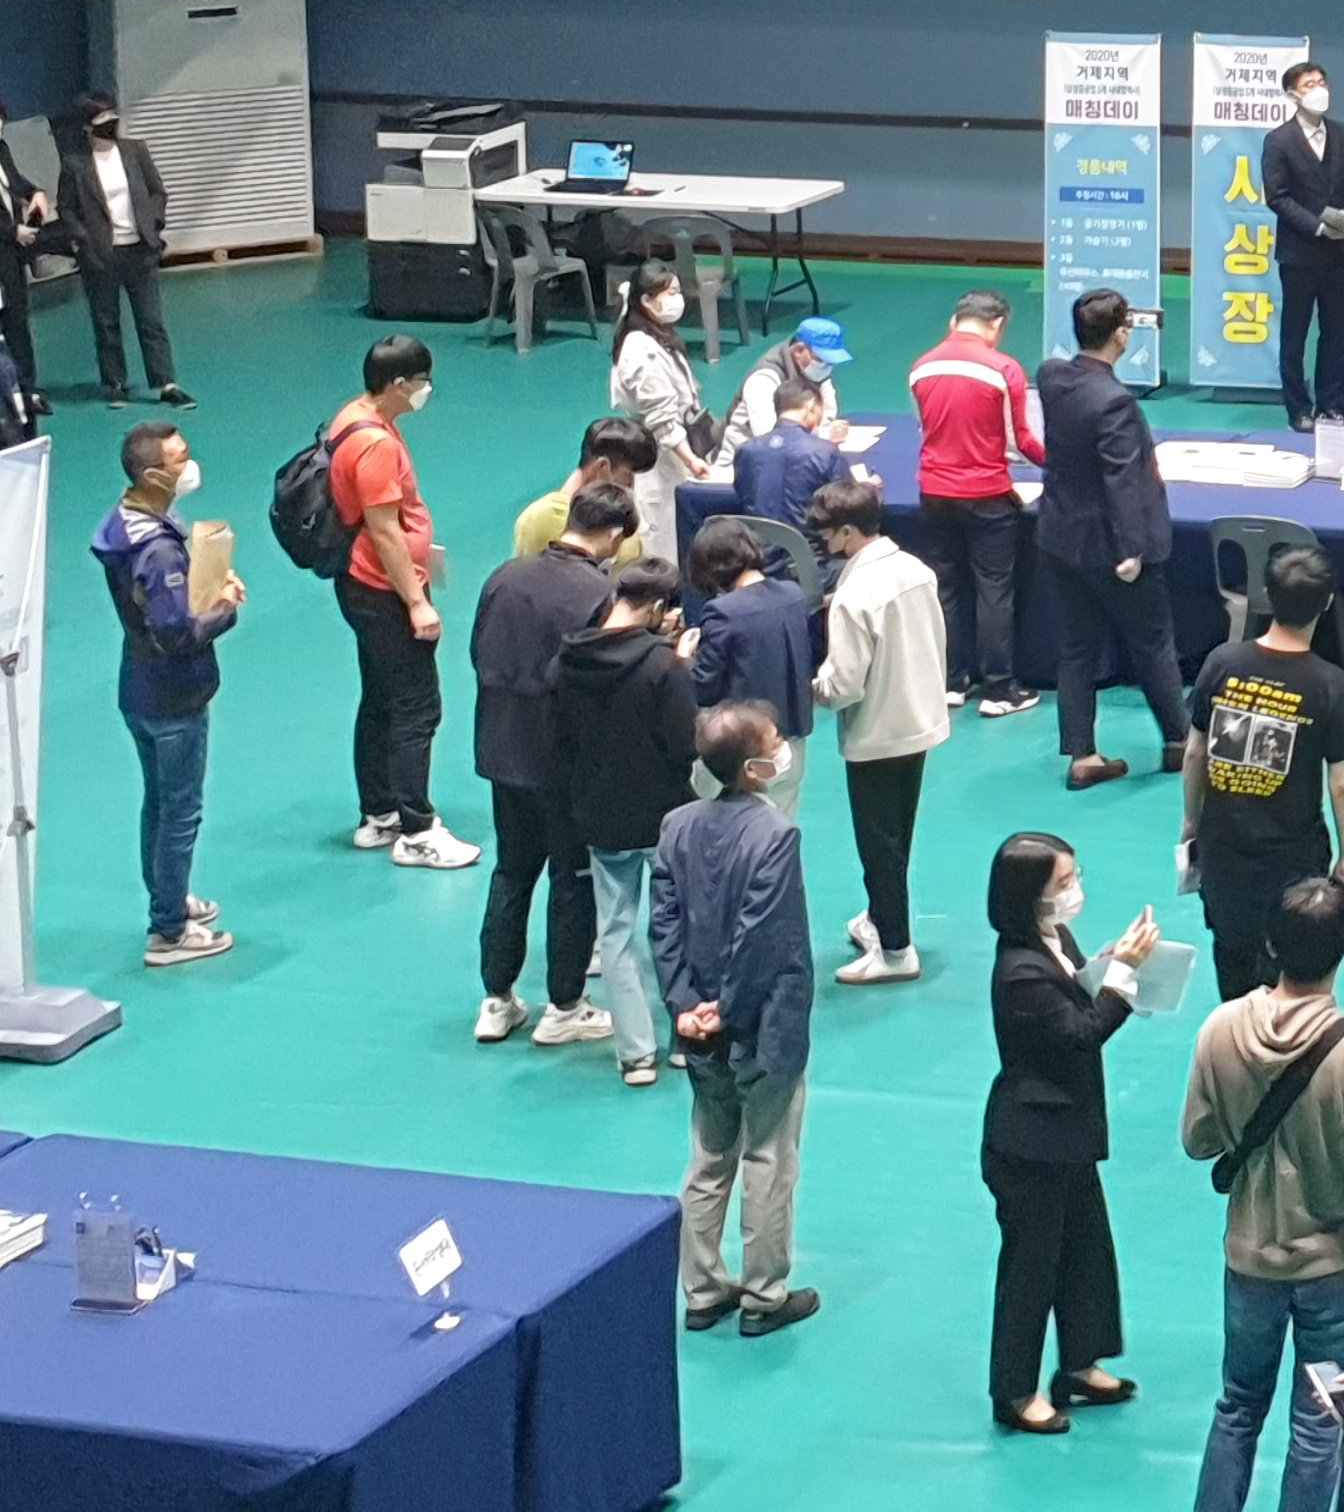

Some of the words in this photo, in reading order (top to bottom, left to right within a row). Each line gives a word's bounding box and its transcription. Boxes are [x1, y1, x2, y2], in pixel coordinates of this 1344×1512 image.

[1085, 49, 1120, 63] 2020년
[1233, 51, 1269, 66] 2020년
[1076, 65, 1130, 82] 거제지역
[1225, 67, 1278, 85] 거제지역
[1065, 98, 1139, 120] 매칭데이
[1213, 100, 1288, 123] 매칭데이
[1076, 158, 1129, 176] 경품내역
[1225, 689, 1254, 704] THE
